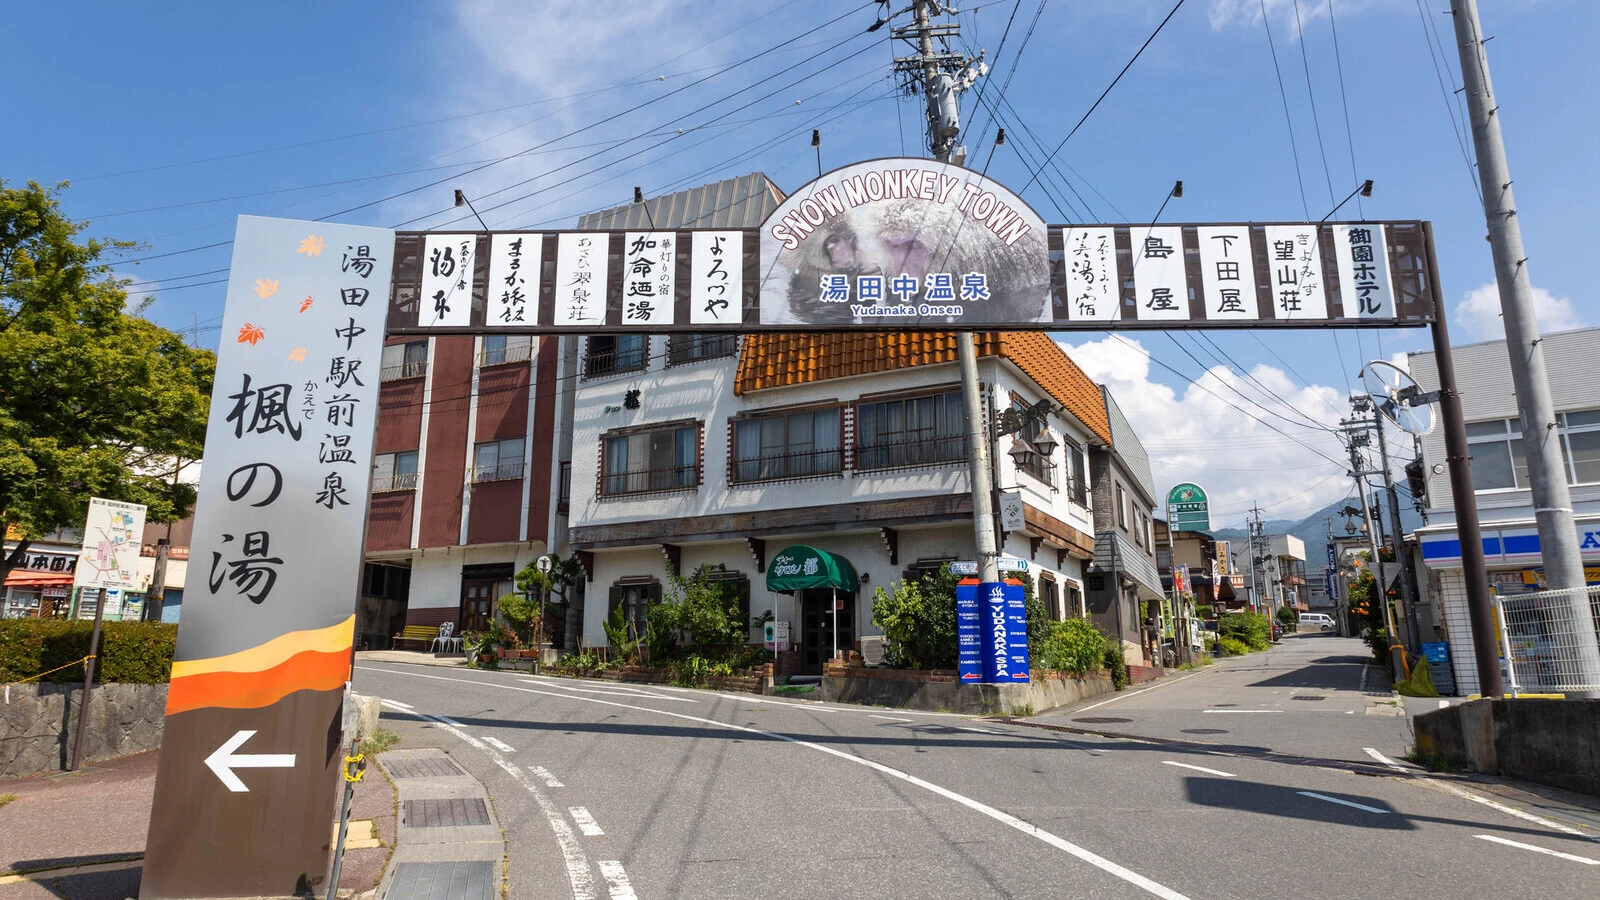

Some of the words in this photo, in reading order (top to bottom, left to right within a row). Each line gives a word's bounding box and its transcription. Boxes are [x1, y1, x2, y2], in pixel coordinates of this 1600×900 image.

[772, 184, 845, 251] SNOW
[841, 169, 958, 208] MONKEY
[957, 182, 1031, 247] TOWN
[657, 238, 672, 296] 華灯りの宿
[704, 235, 729, 320] よろづや
[820, 274, 990, 301] 湯田中温泉
[1144, 236, 1180, 311] 島屋
[1210, 235, 1246, 313] 下田屋
[1273, 239, 1302, 311] 望山荘
[1296, 233, 1317, 297] きよみず
[1348, 228, 1382, 314] 御園ホテル
[851, 304, 917, 316] Yudanaka
[920, 305, 962, 315] Onsen
[301, 380, 318, 420] かえで
[315, 244, 377, 510] 湯田中駅前温泉
[208, 373, 302, 605] 楓の湯
[774, 564, 802, 576] サロン
[1495, 572, 1522, 582] ATM
[991, 605, 1008, 656] YUDANAKA
[995, 656, 1009, 676] SPA
